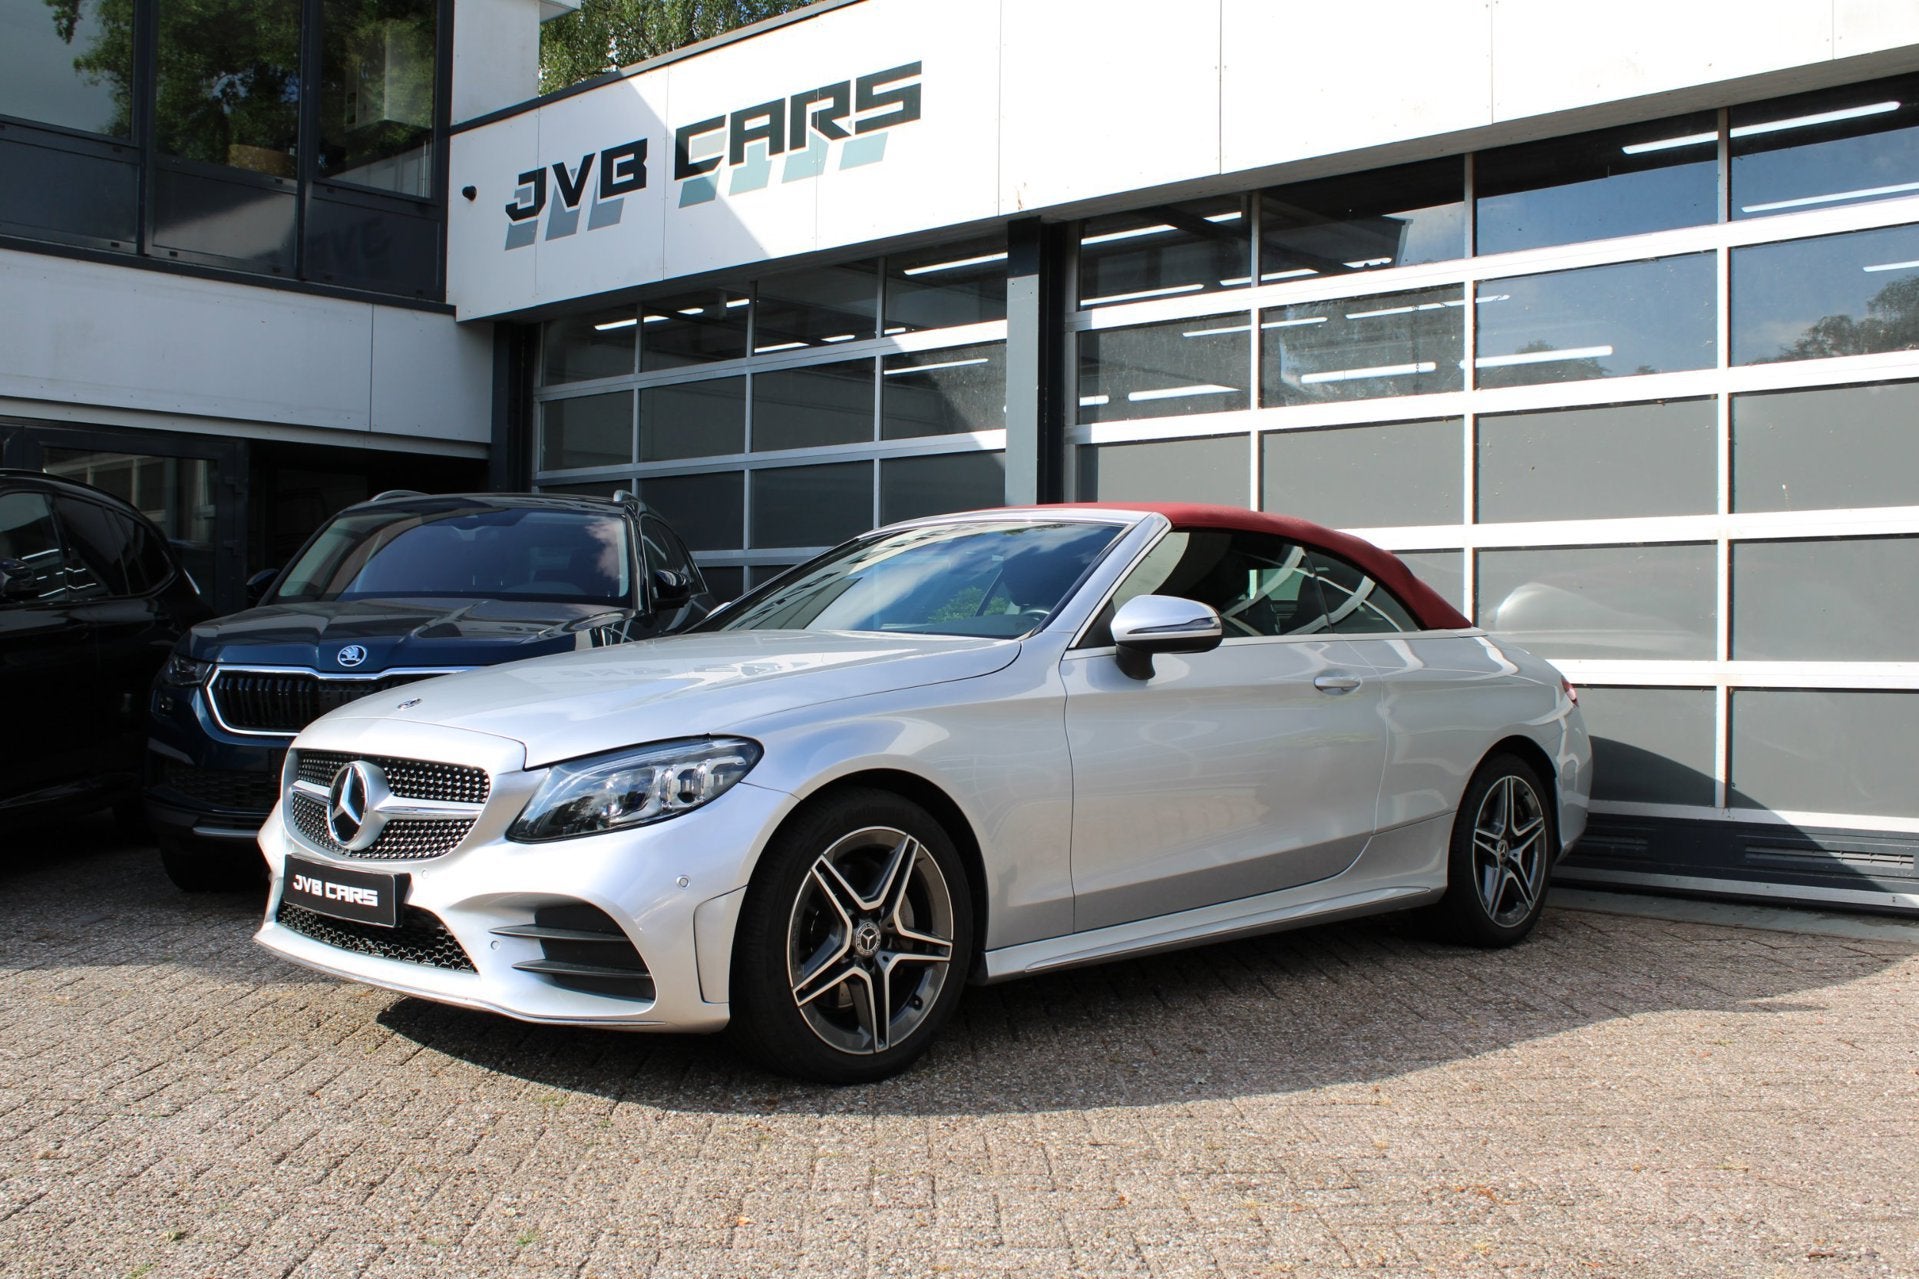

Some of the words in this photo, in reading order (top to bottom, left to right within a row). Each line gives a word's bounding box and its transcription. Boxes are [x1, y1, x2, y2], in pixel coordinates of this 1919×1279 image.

[505, 138, 648, 221] JVB
[674, 60, 922, 180] CARS
[293, 874, 322, 896] JVB
[325, 881, 378, 907] CARS
